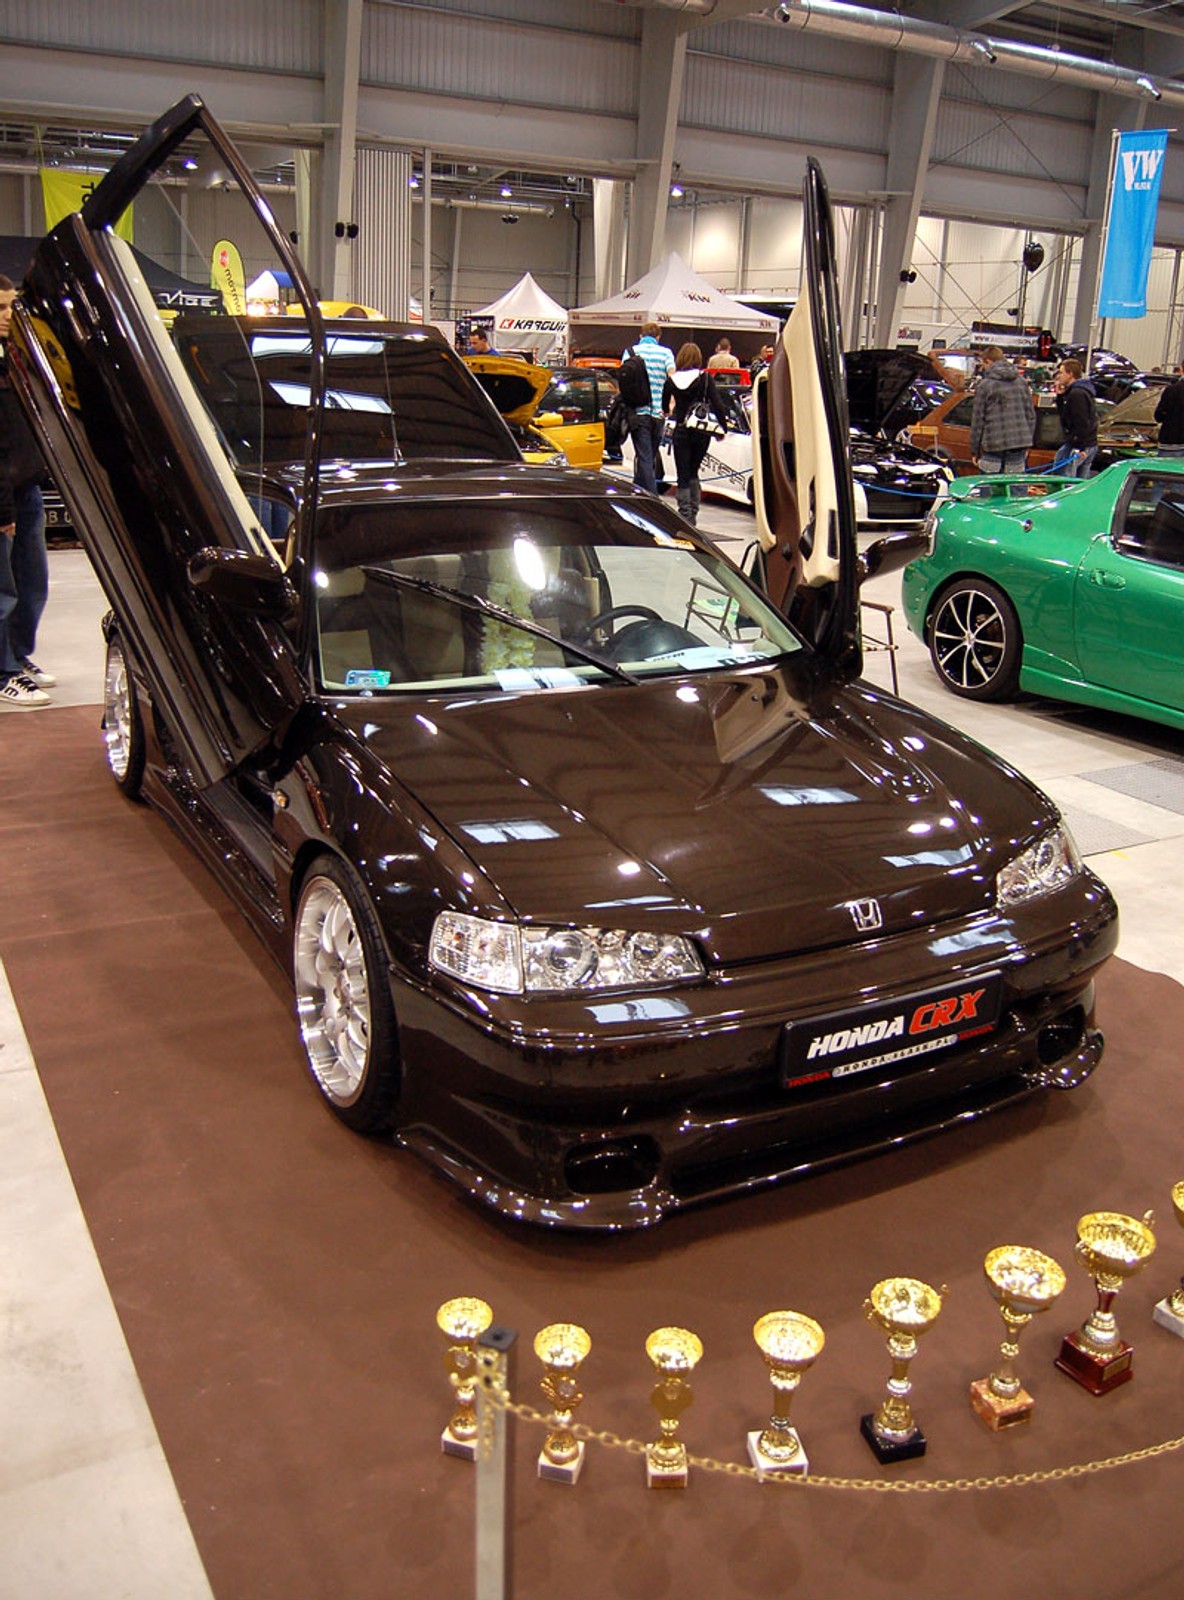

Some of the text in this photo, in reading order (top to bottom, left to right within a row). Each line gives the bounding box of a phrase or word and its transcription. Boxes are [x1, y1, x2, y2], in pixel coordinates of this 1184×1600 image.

[1122, 150, 1163, 191] VW
[159, 290, 219, 308] VIBE
[807, 988, 986, 1059] HONDA CRX
